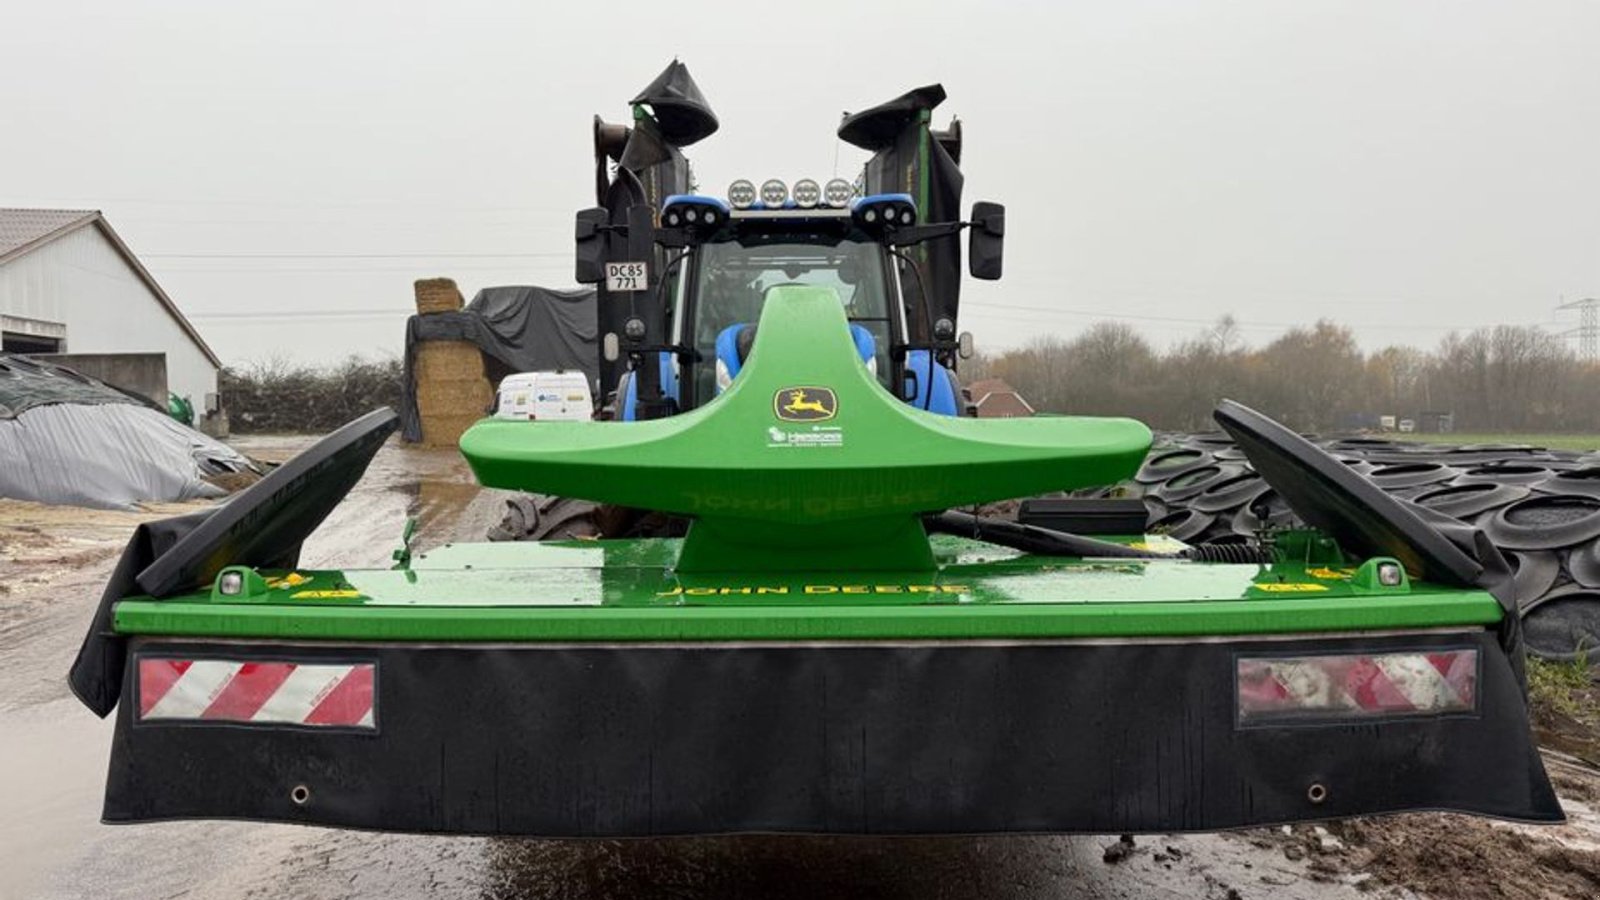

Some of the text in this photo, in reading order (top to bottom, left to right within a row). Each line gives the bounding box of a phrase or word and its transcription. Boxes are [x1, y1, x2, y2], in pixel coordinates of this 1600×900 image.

[610, 265, 643, 277] DC85
[616, 277, 637, 289] 771
[656, 584, 970, 596] JOHN DEERE
